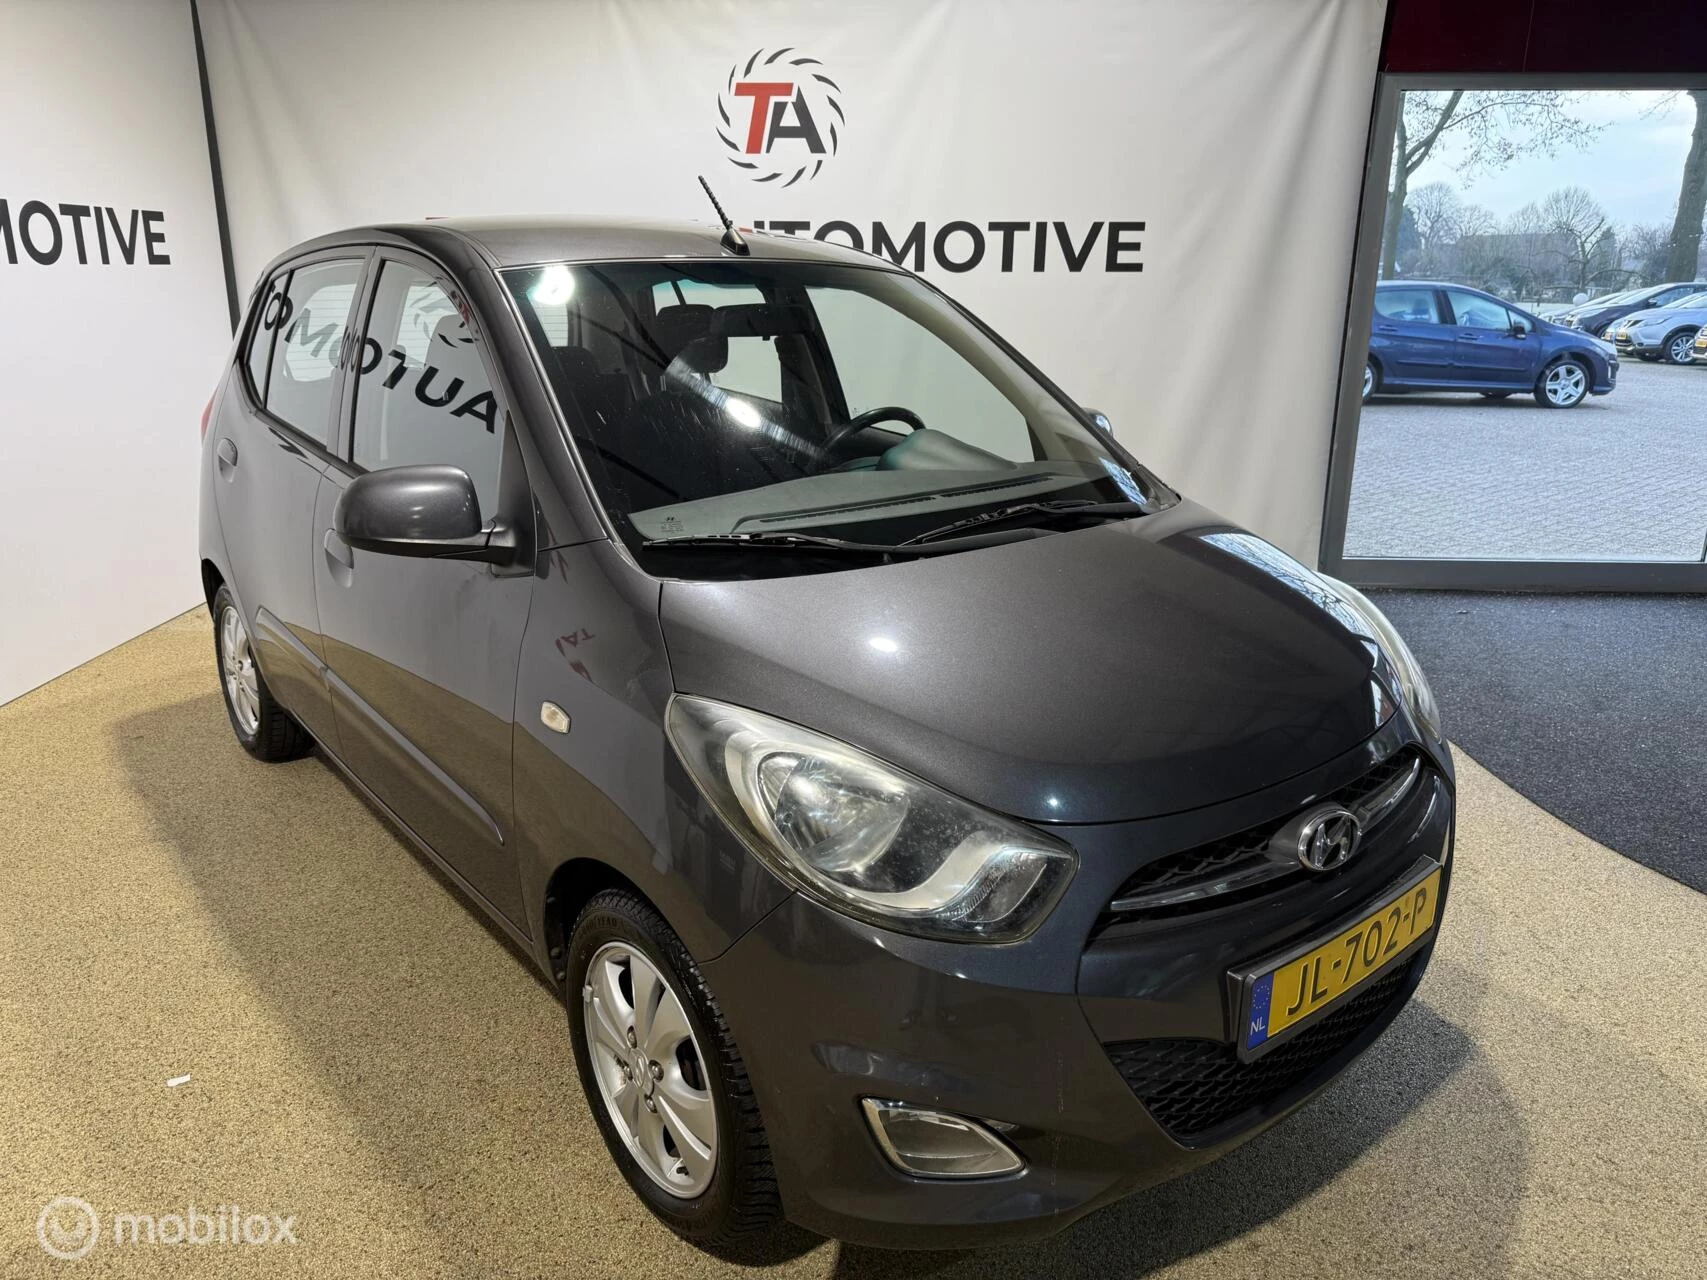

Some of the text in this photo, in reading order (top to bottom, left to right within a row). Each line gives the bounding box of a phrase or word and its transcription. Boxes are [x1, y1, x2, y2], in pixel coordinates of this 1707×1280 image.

[734, 82, 827, 154] TA
[1286, 887, 1427, 1017] JL-702-P
[1250, 1016, 1266, 1035] NL
